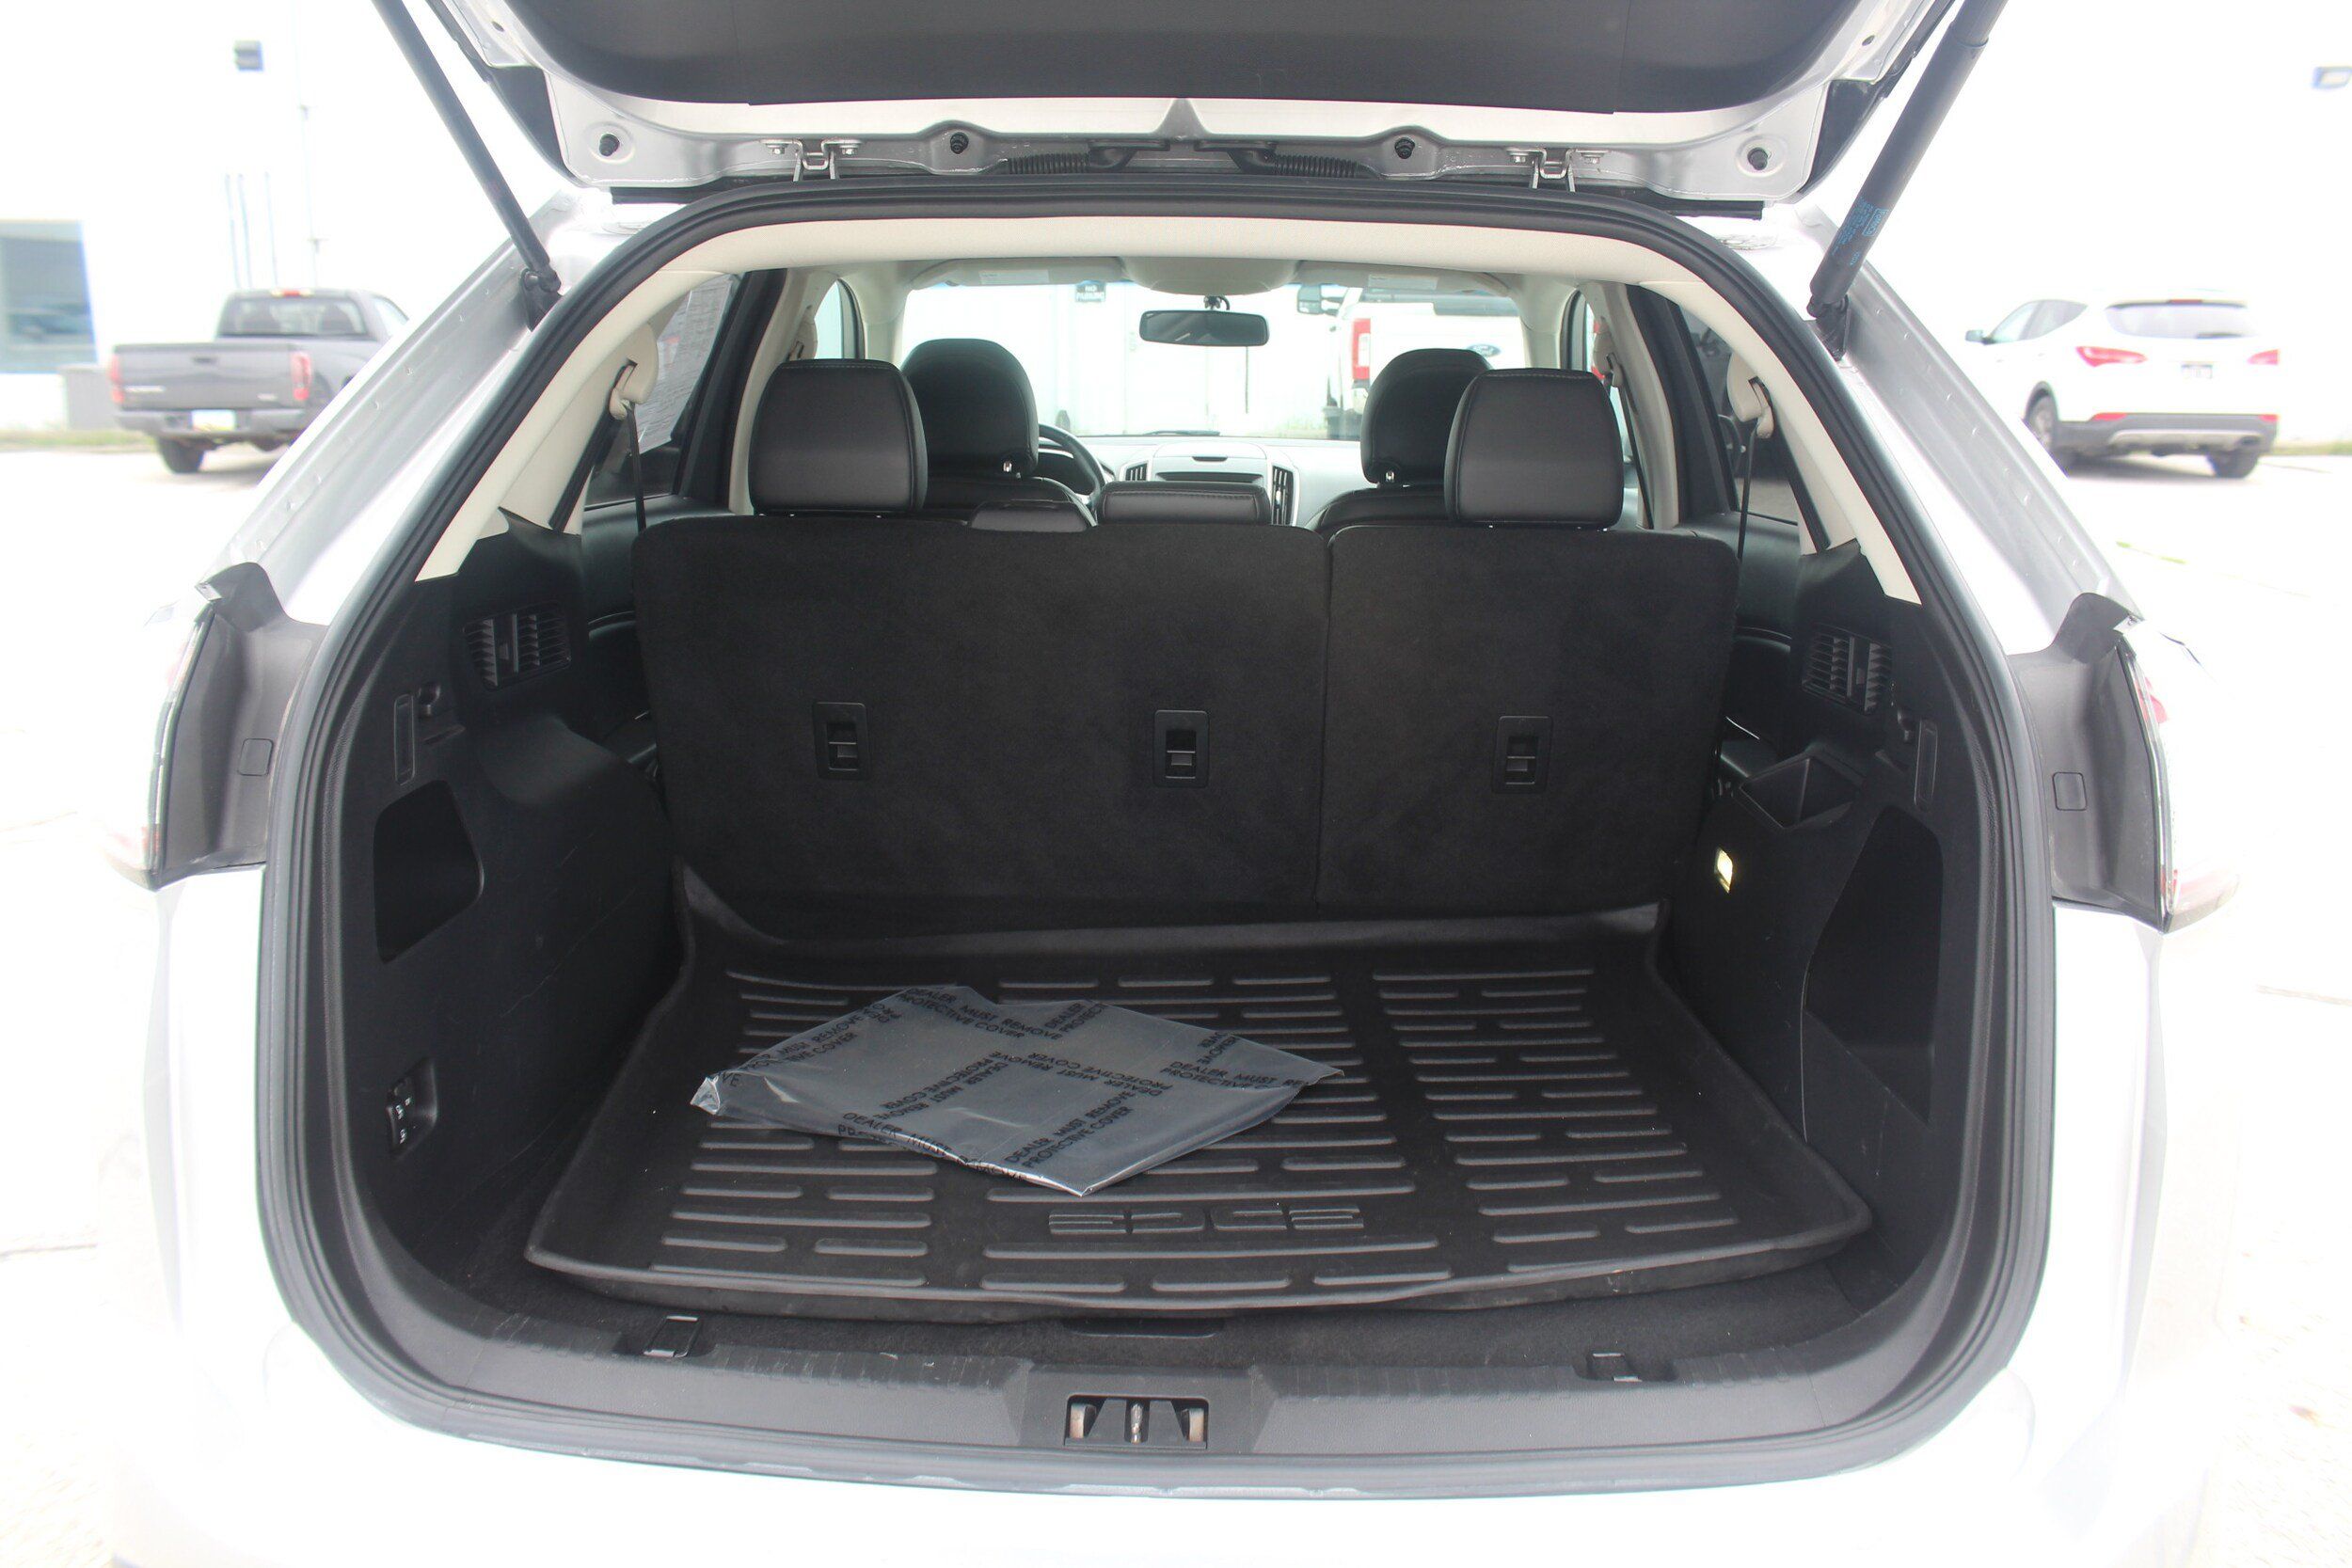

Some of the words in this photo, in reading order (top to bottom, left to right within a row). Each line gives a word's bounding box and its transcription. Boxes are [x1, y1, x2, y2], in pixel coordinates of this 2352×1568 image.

[812, 1013, 865, 1043] REMOVE
[975, 1021, 1025, 1038] COVER
[813, 1031, 858, 1054] COVER
[842, 1111, 903, 1139] DEALER
[1005, 1137, 1054, 1164] DEALER
[1085, 1090, 1136, 1119] REMOVE
[1090, 1105, 1135, 1130] COVER
